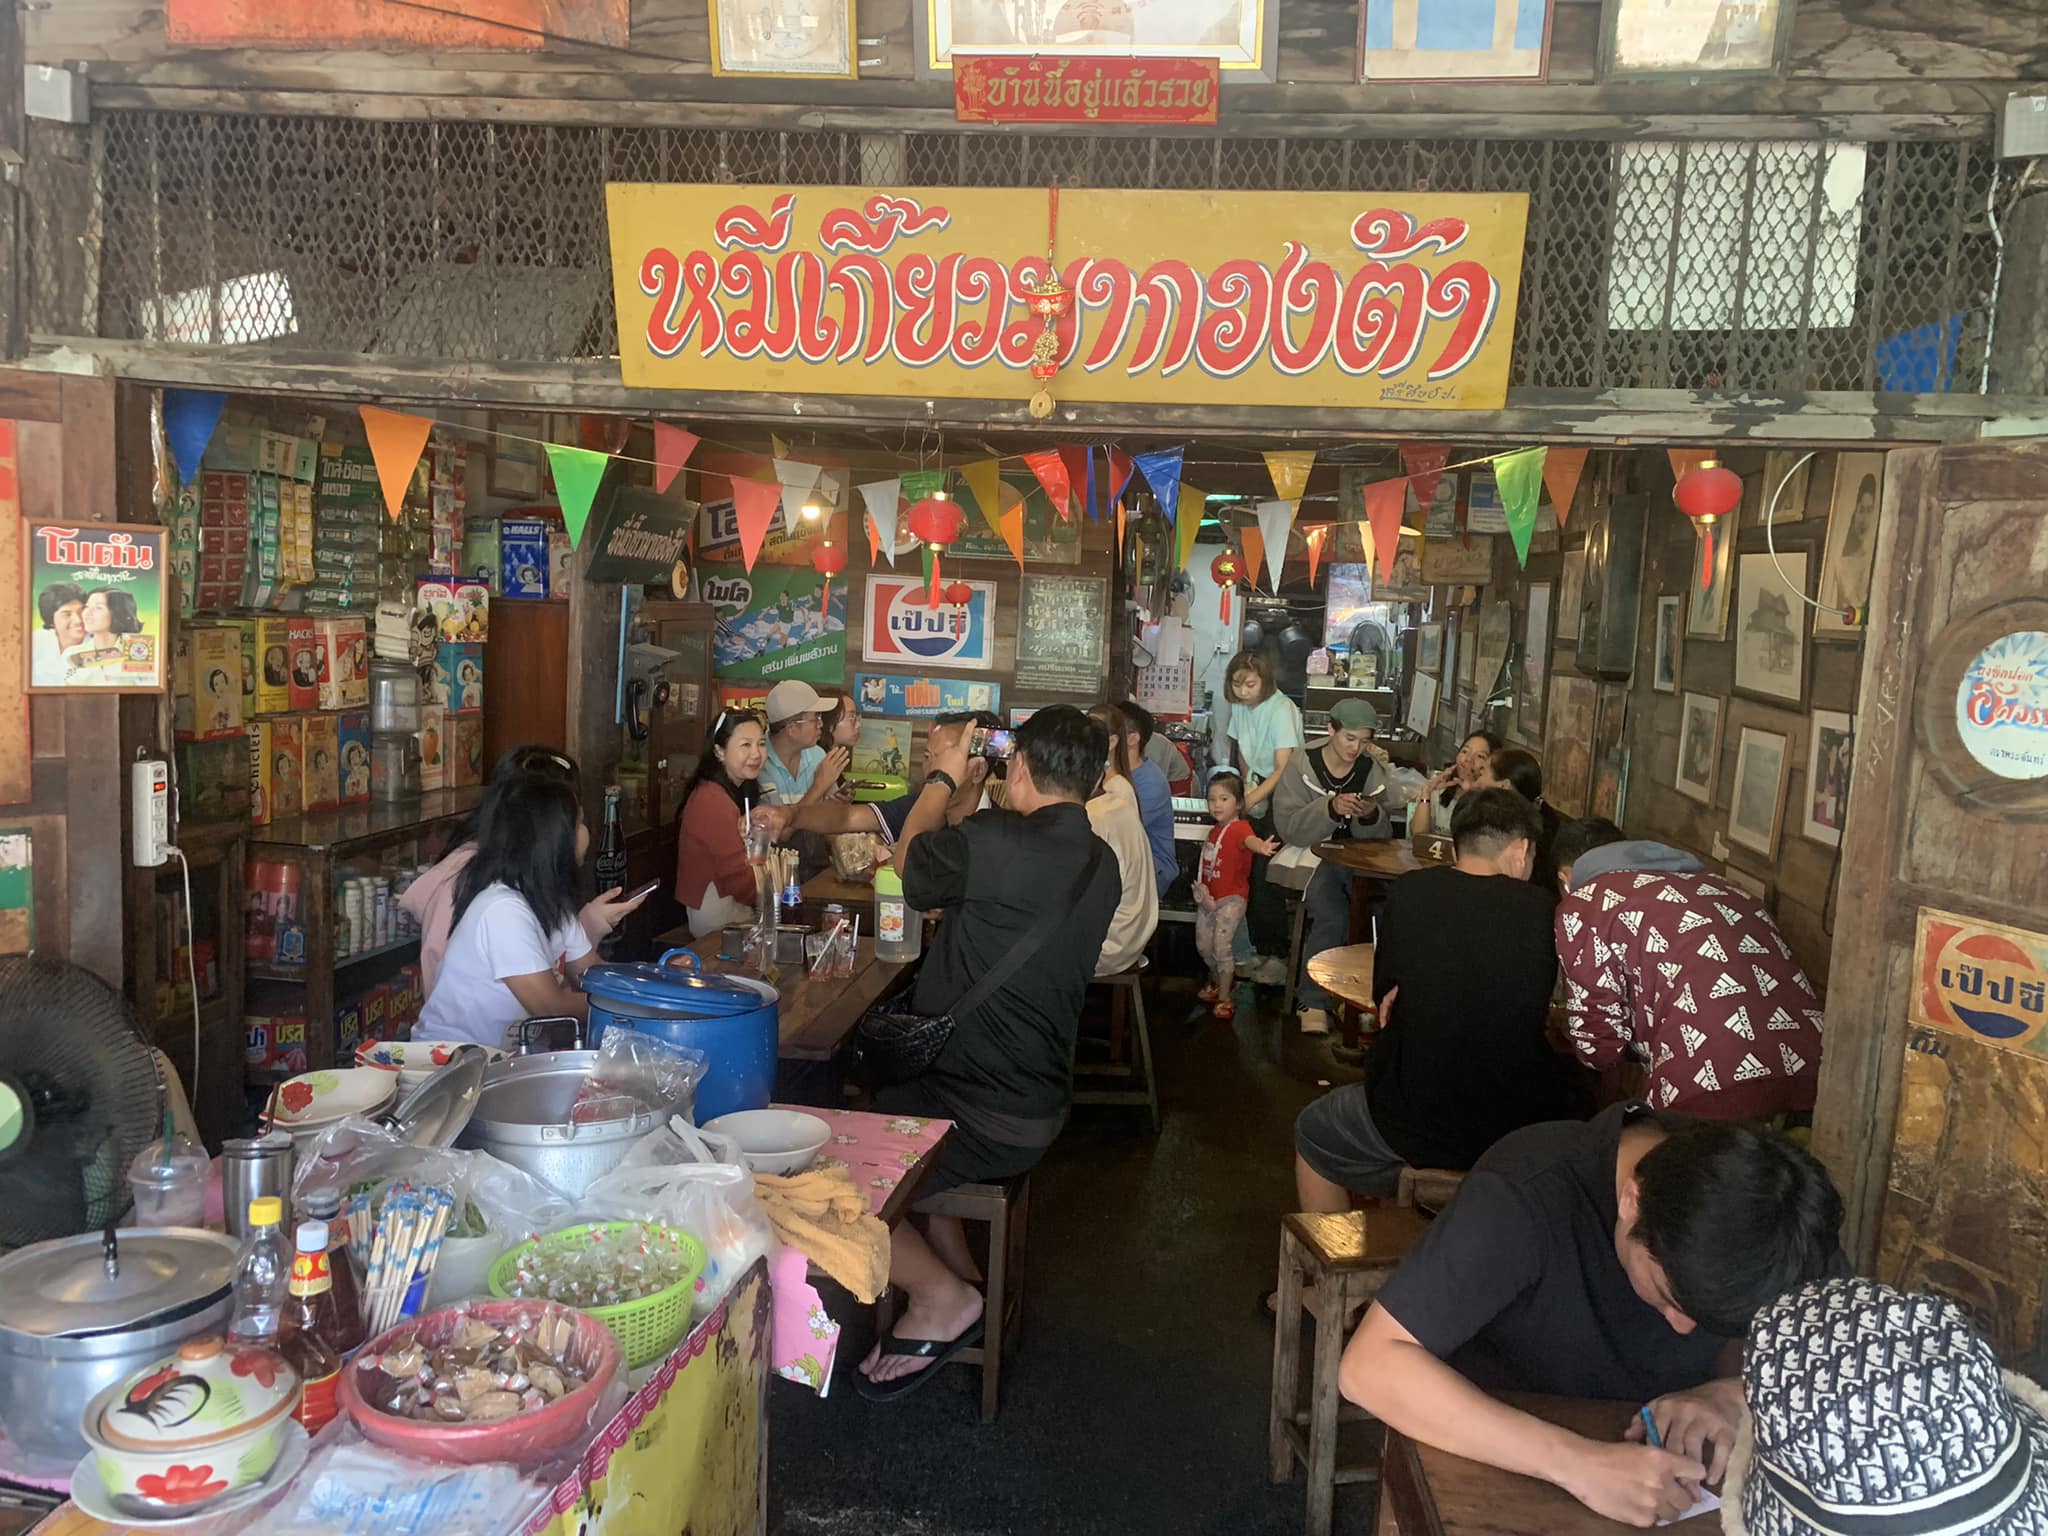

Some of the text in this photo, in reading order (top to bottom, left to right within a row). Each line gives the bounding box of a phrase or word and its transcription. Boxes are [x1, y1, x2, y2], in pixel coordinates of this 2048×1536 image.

[987, 59, 1211, 118] บ้านนี้อยู่แล้วรวย
[511, 525, 540, 536] HALLS
[708, 580, 750, 603] ไมโล
[1428, 841, 1443, 860] 4
[1767, 1022, 1800, 1030] adidas
[1733, 1066, 1772, 1081] adidas
